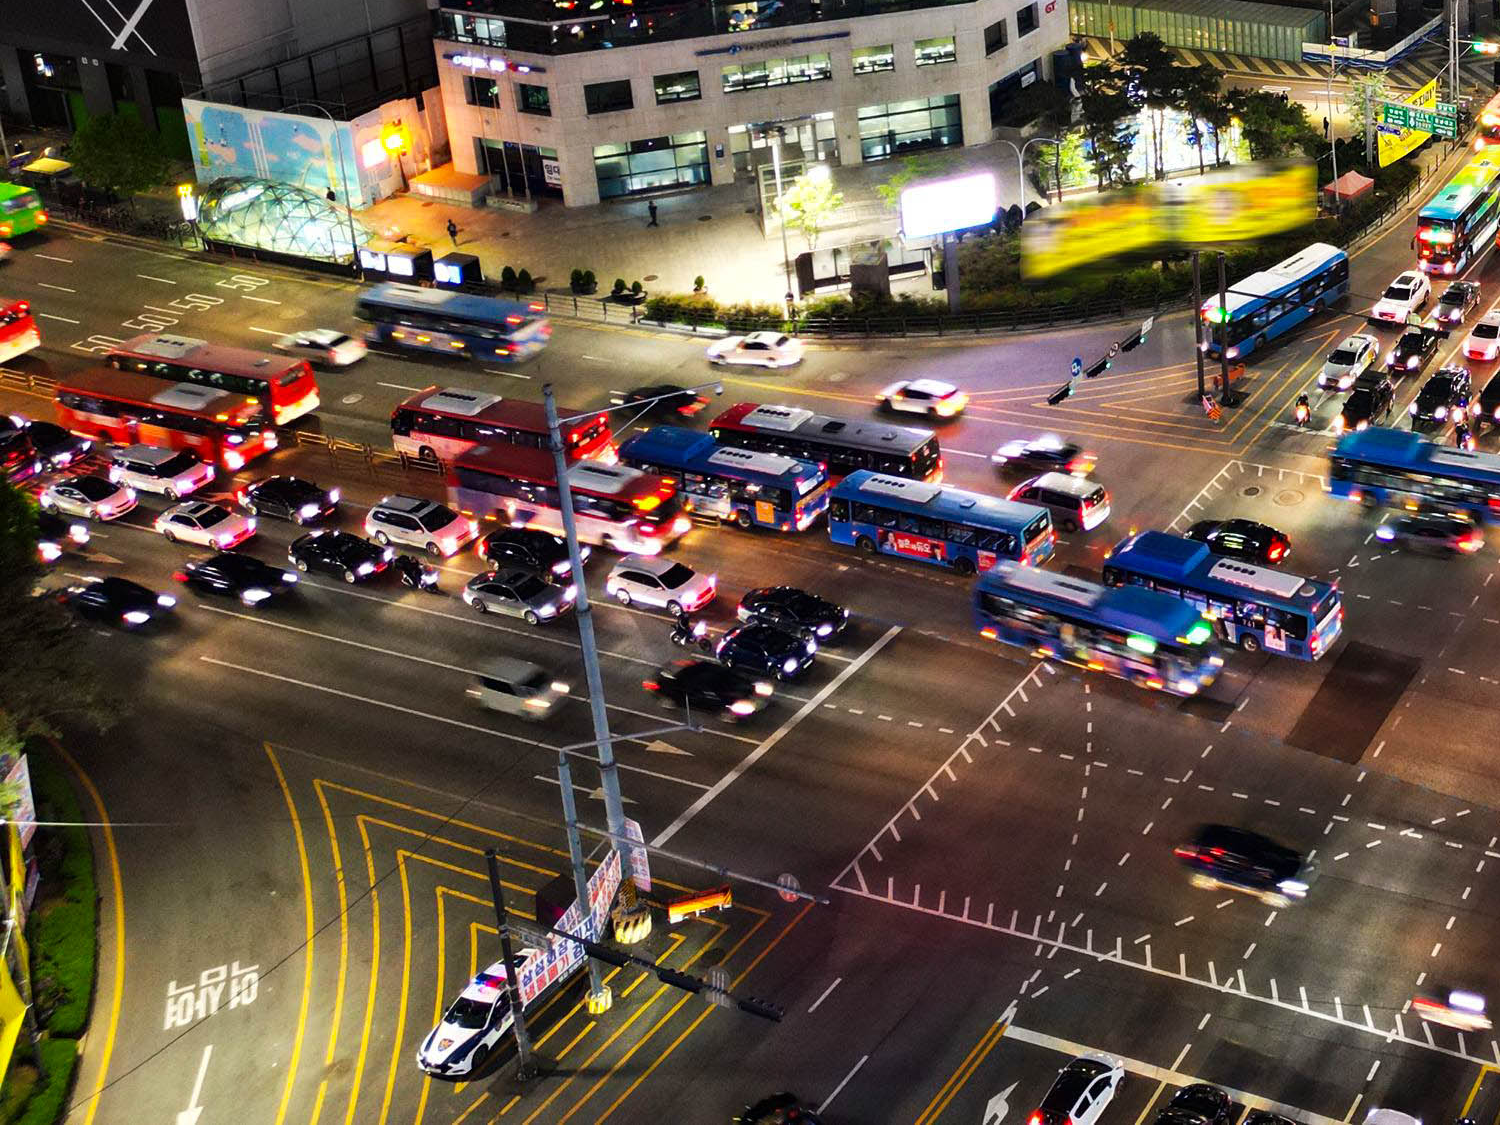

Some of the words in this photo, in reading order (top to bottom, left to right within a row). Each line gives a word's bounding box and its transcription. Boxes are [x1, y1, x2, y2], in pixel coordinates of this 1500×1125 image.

[1045, 0, 1057, 14] GT
[215, 274, 270, 292] 50
[168, 293, 225, 312] 50
[121, 313, 180, 333] 50
[70, 334, 127, 355] 50
[163, 960, 260, 1031] 역삼역
